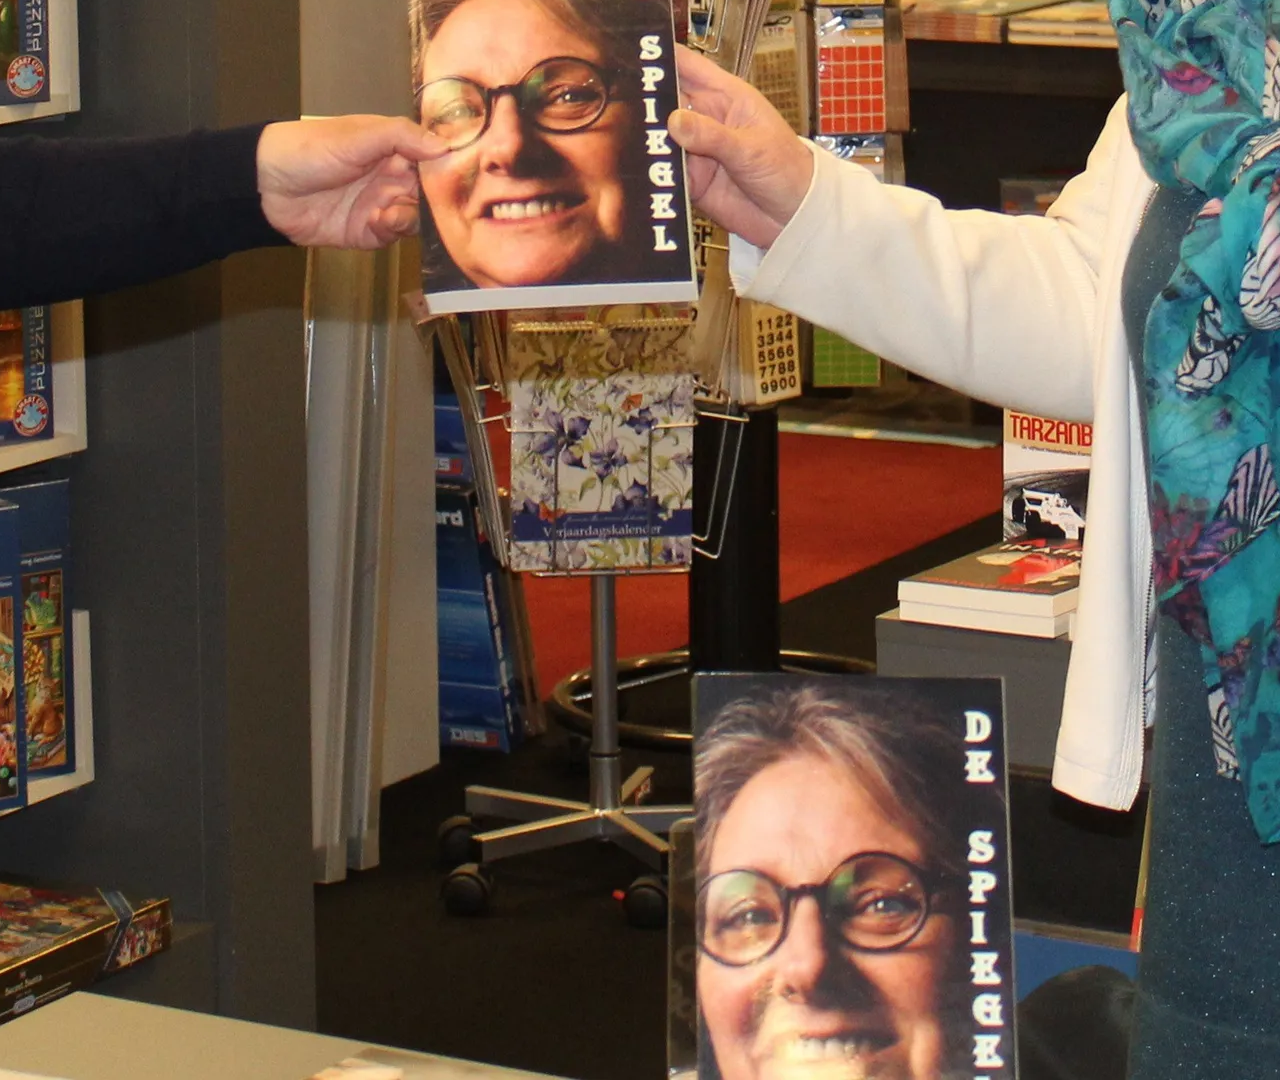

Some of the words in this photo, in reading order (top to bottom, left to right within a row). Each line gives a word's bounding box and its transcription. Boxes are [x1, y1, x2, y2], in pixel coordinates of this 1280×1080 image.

[639, 35, 678, 252] SPIEGEL
[757, 313, 793, 333] 1122
[35, 306, 45, 390] PUZZLE
[757, 330, 794, 348] 3344
[758, 345, 794, 363] 5566
[759, 360, 796, 379] 7788
[761, 376, 797, 394] 9900
[543, 524, 663, 541] Verjaardagskalender
[964, 711, 995, 782] DE
[967, 831, 1004, 1080] SPIEGE
